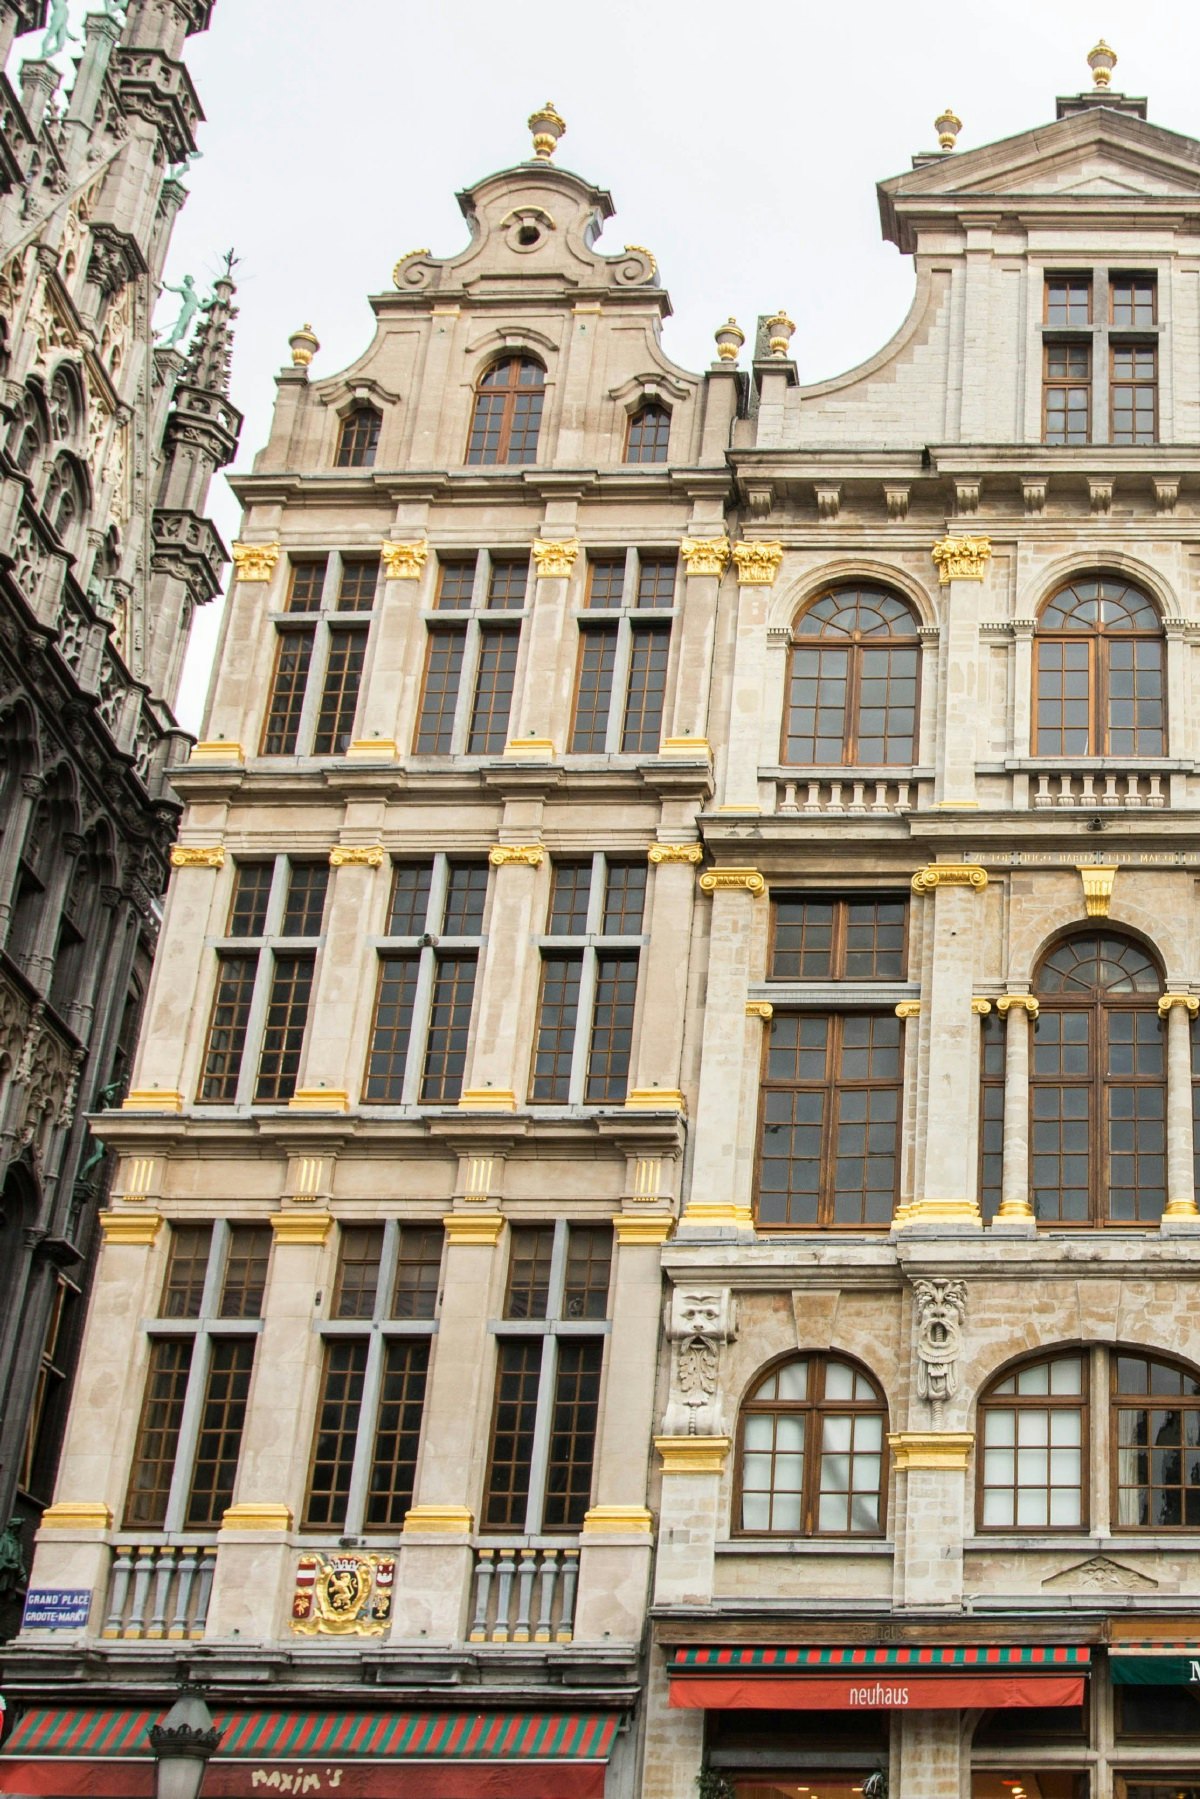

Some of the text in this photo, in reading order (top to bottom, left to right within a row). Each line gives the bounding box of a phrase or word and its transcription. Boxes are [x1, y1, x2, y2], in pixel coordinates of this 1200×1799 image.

[61, 1594, 90, 1605] PLACE
[25, 1610, 88, 1621] GROOTE-MARKT
[849, 1682, 909, 1705] neuhaus
